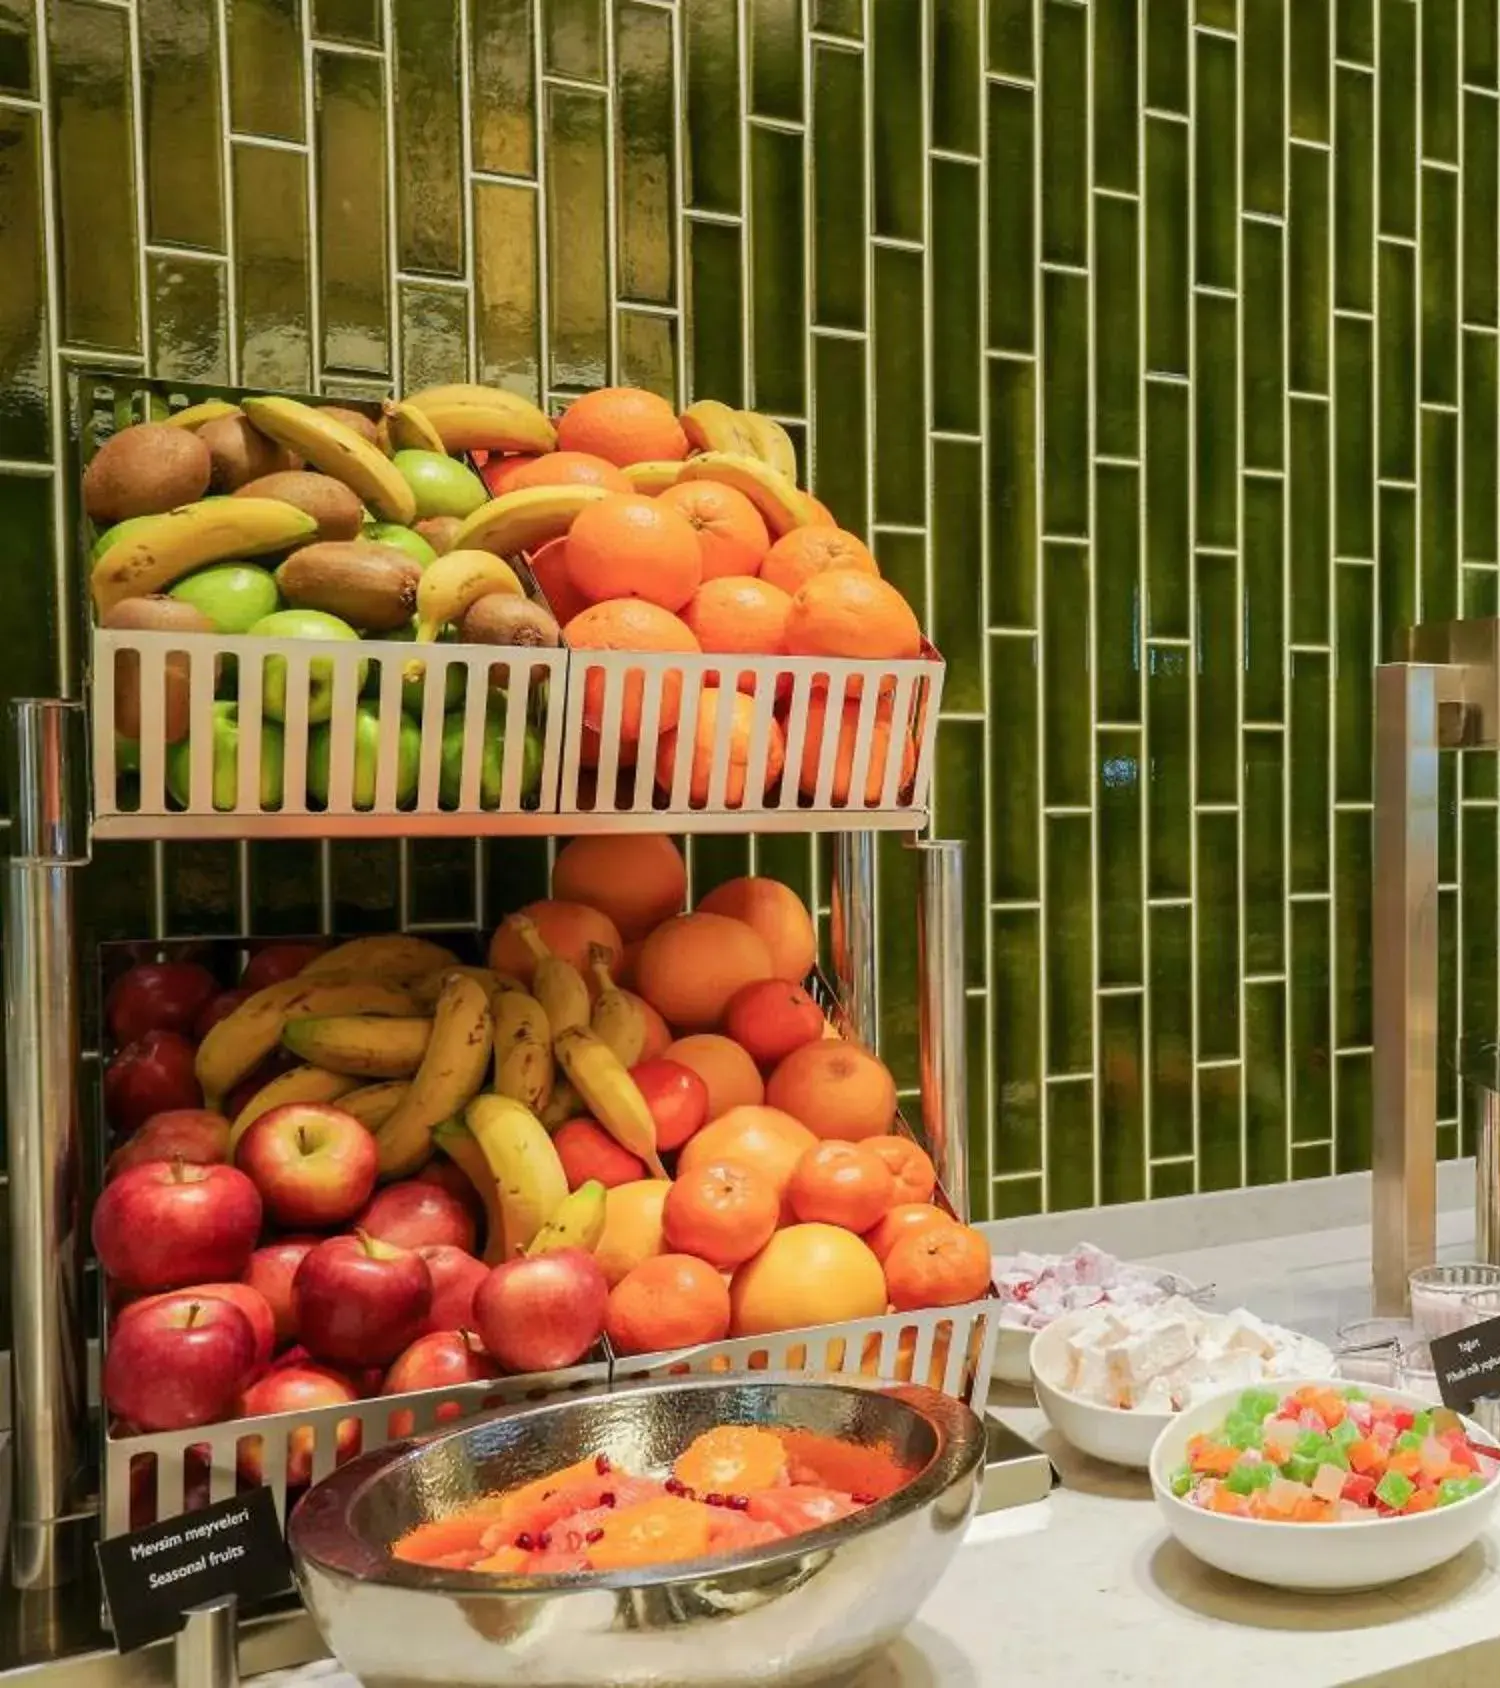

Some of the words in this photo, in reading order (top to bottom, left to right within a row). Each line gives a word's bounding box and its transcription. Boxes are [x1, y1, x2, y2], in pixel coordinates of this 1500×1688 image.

[130, 1532, 182, 1562] Mevsim
[185, 1508, 249, 1543] meyveleri
[149, 1555, 206, 1589] Seasonal
[209, 1544, 246, 1569] fruits
